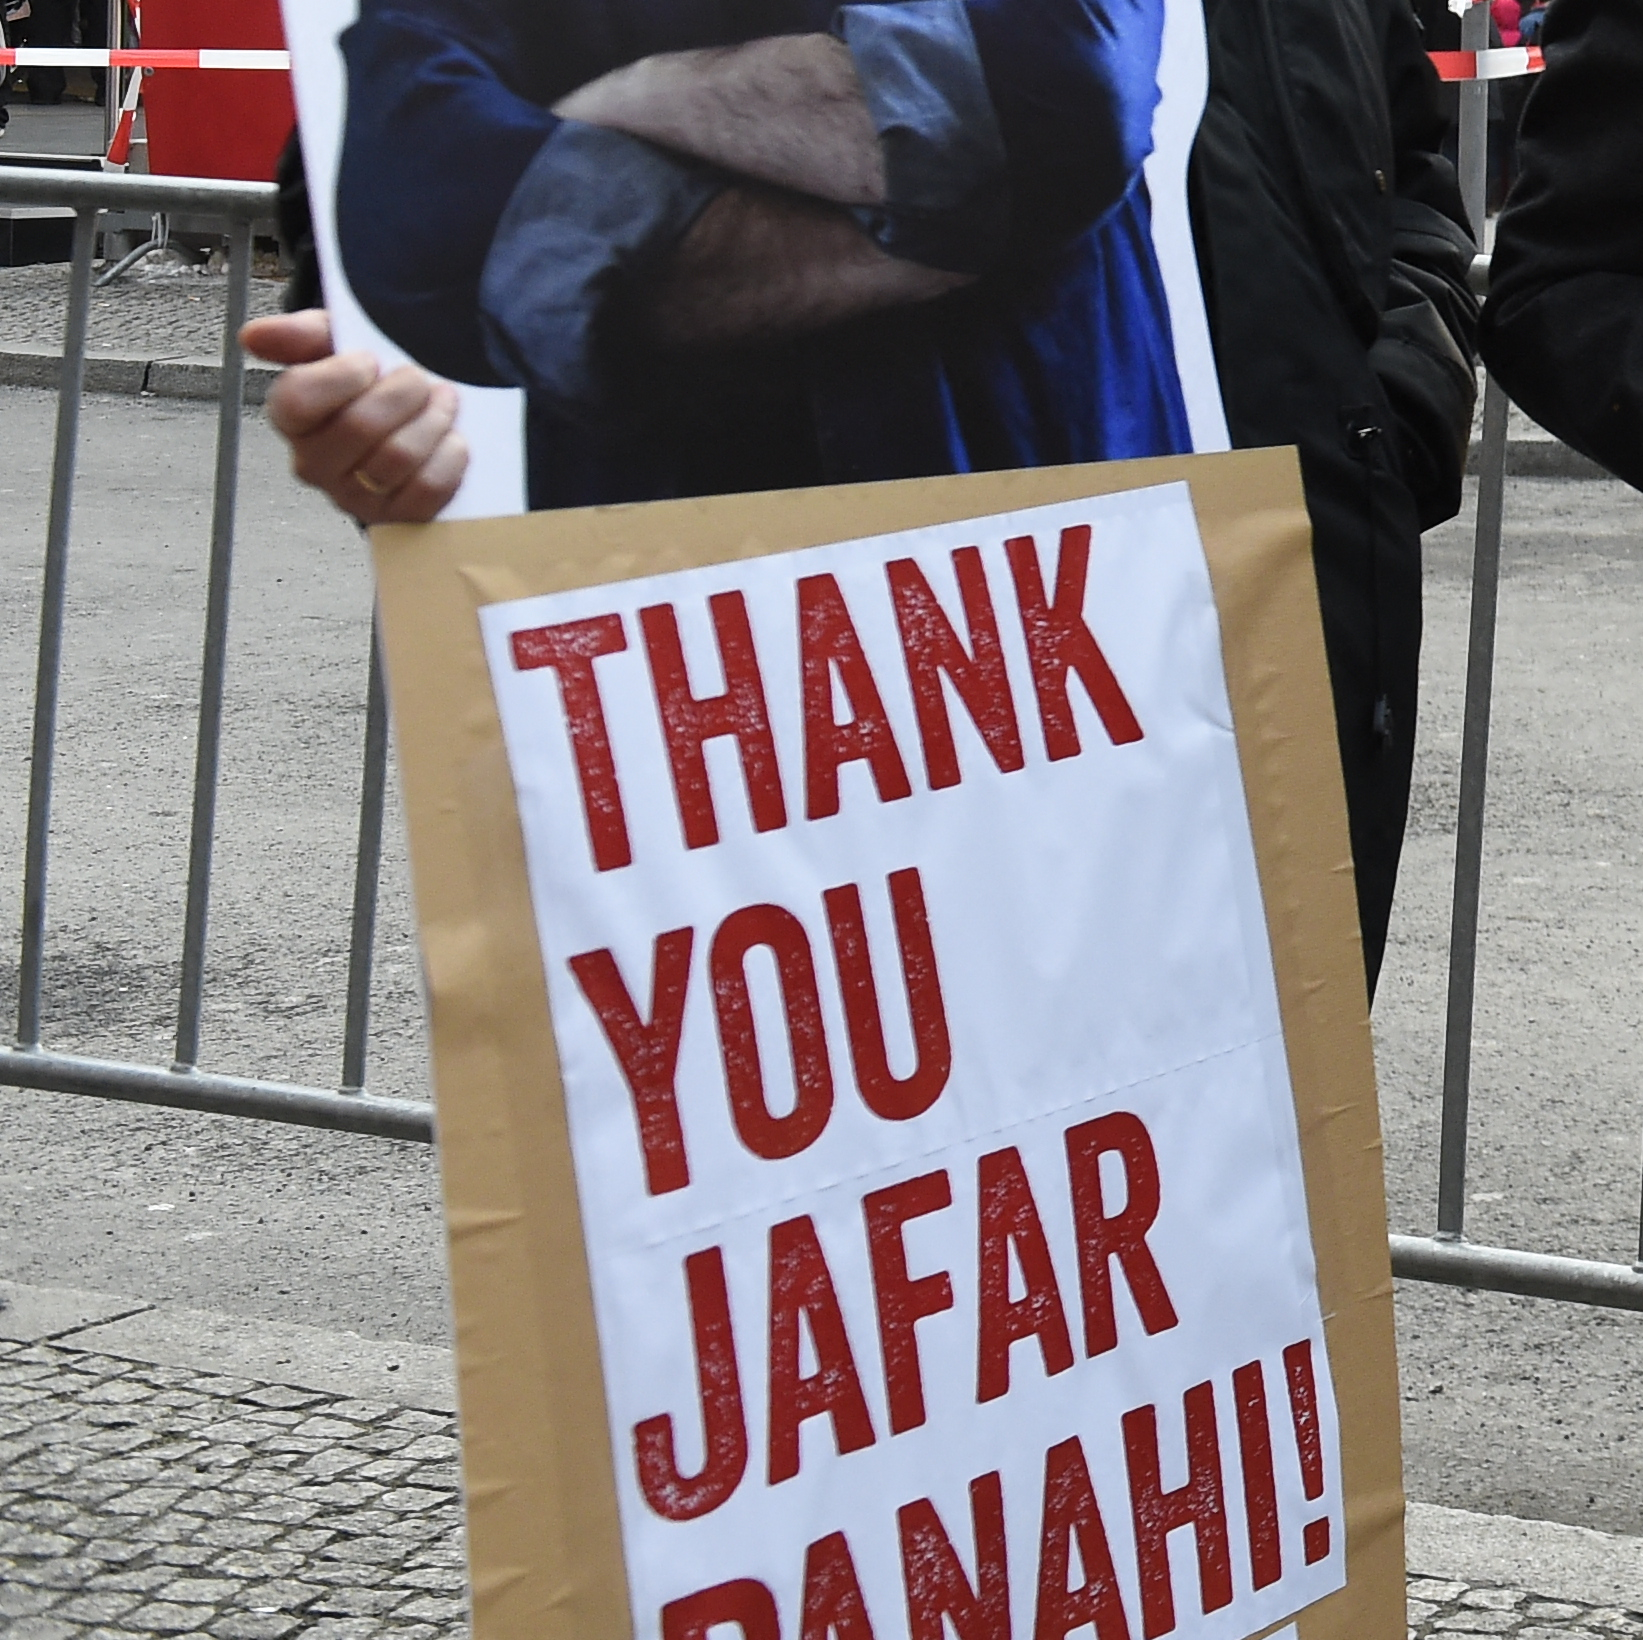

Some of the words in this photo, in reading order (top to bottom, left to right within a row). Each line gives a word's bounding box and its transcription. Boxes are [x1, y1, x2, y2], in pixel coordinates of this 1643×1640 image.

[512, 524, 1144, 871] THANK
[569, 867, 952, 1196] YOU
[634, 1110, 1178, 1521] JAFAR
[660, 1340, 1331, 1640] NAHI!
